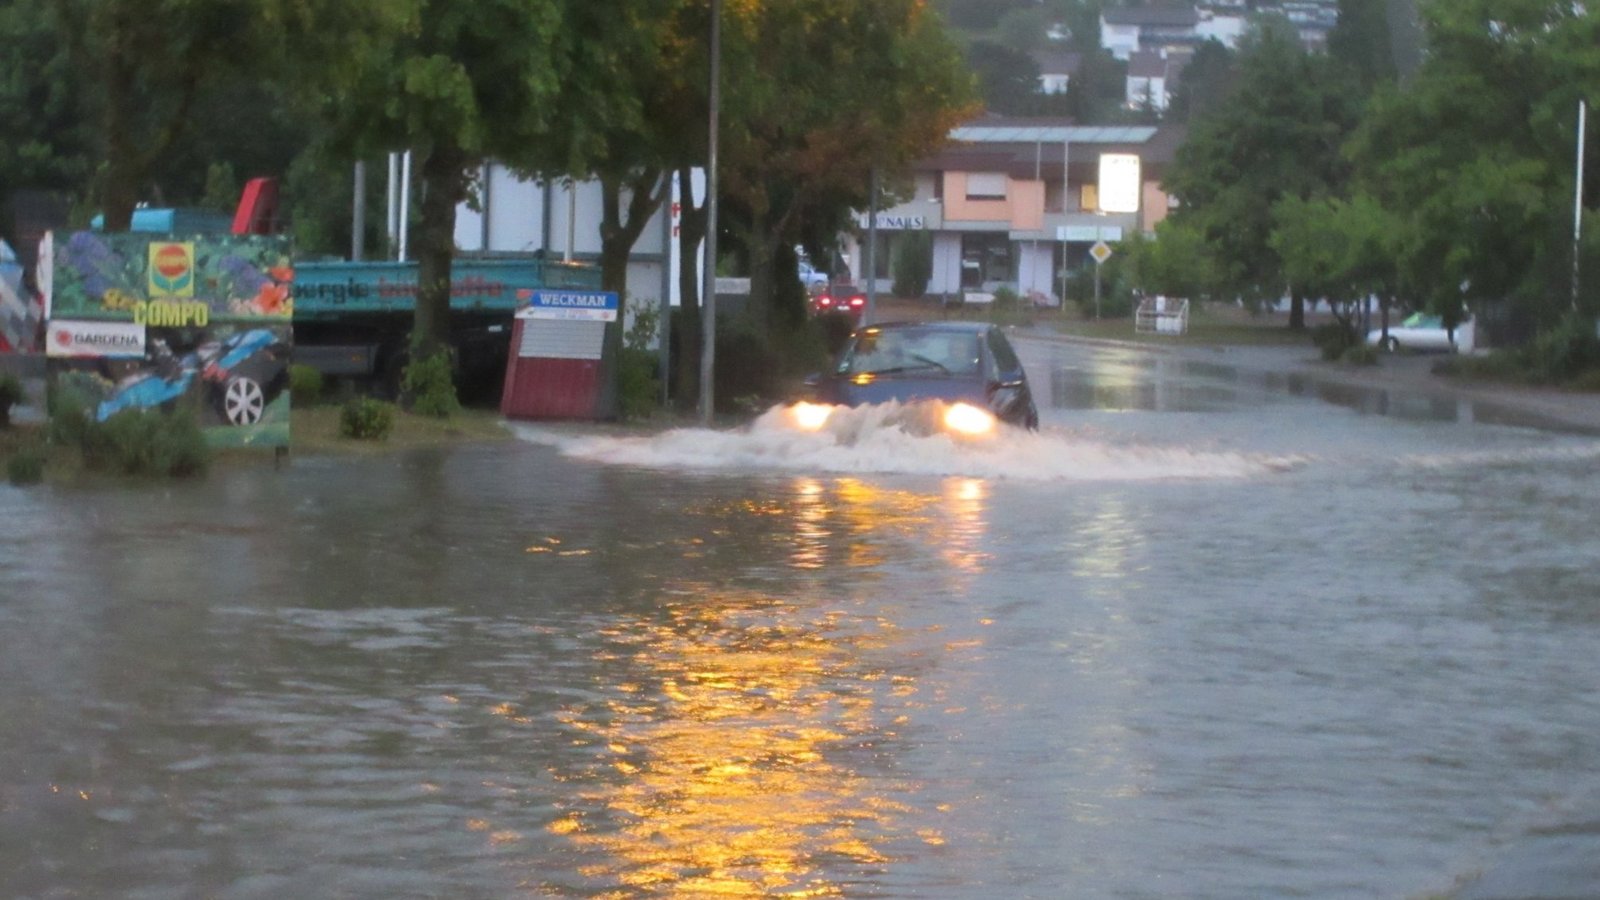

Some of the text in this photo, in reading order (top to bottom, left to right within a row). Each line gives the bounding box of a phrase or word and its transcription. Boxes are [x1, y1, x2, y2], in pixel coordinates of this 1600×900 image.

[886, 216, 922, 227] NAILS
[539, 292, 607, 306] WECKMAN
[133, 300, 209, 327] COMPO
[73, 333, 140, 346] GARDENA
